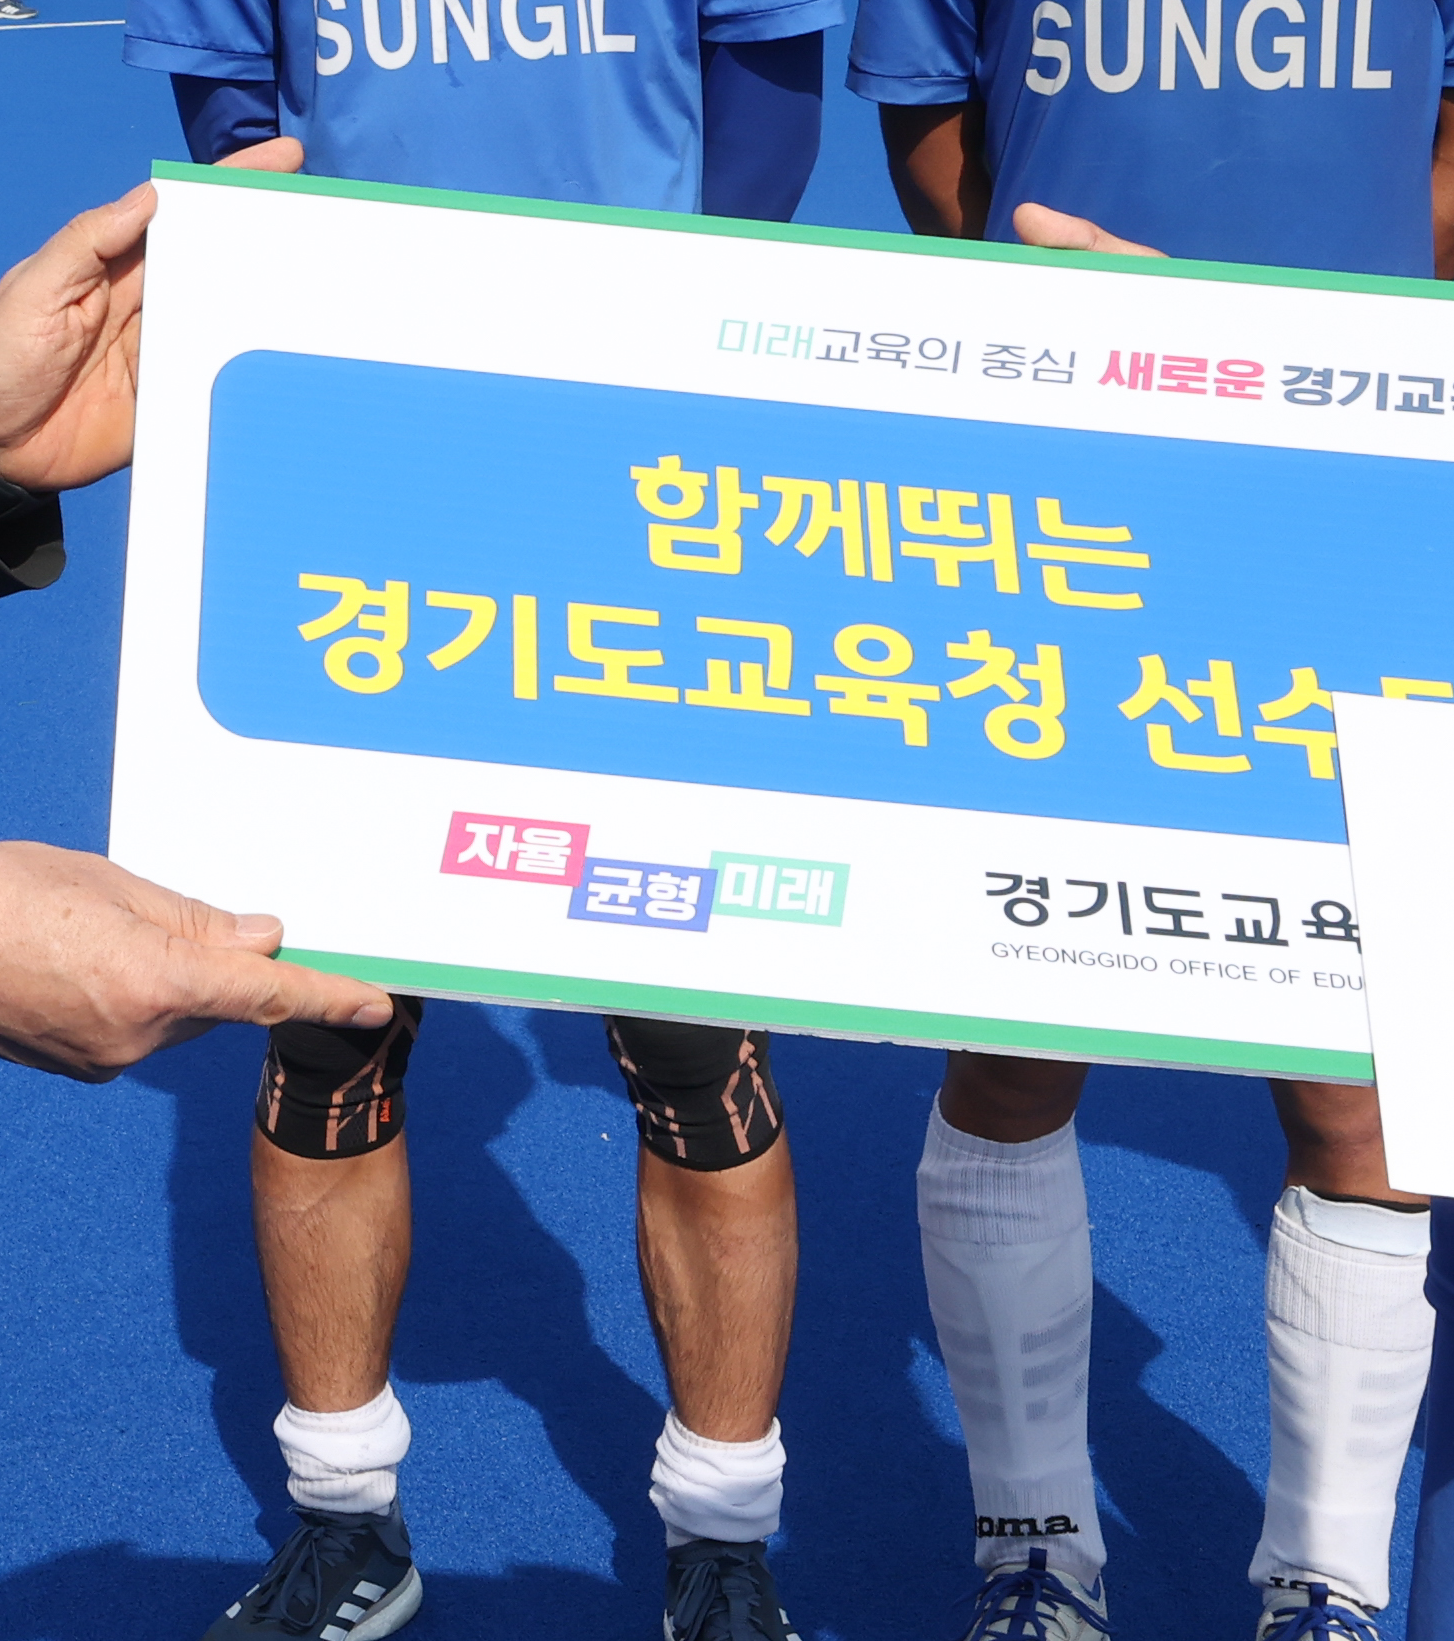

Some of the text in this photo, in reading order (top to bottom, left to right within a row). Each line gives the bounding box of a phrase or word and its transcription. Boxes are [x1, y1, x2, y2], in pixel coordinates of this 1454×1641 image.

[716, 318, 962, 375] 미래교육의
[979, 341, 1078, 386] 중심
[1098, 349, 1267, 401] 새로운
[628, 453, 1151, 611] 함께뛰는
[295, 570, 1069, 760] 경기도교육청
[456, 821, 573, 877] 자율
[585, 865, 702, 922] 균형
[718, 861, 835, 917] 미래
[984, 870, 1363, 956] 경기도교육
[990, 941, 1364, 993] GYEONGGIDO OFFICE OF EDU
[975, 1514, 1080, 1538] oma
